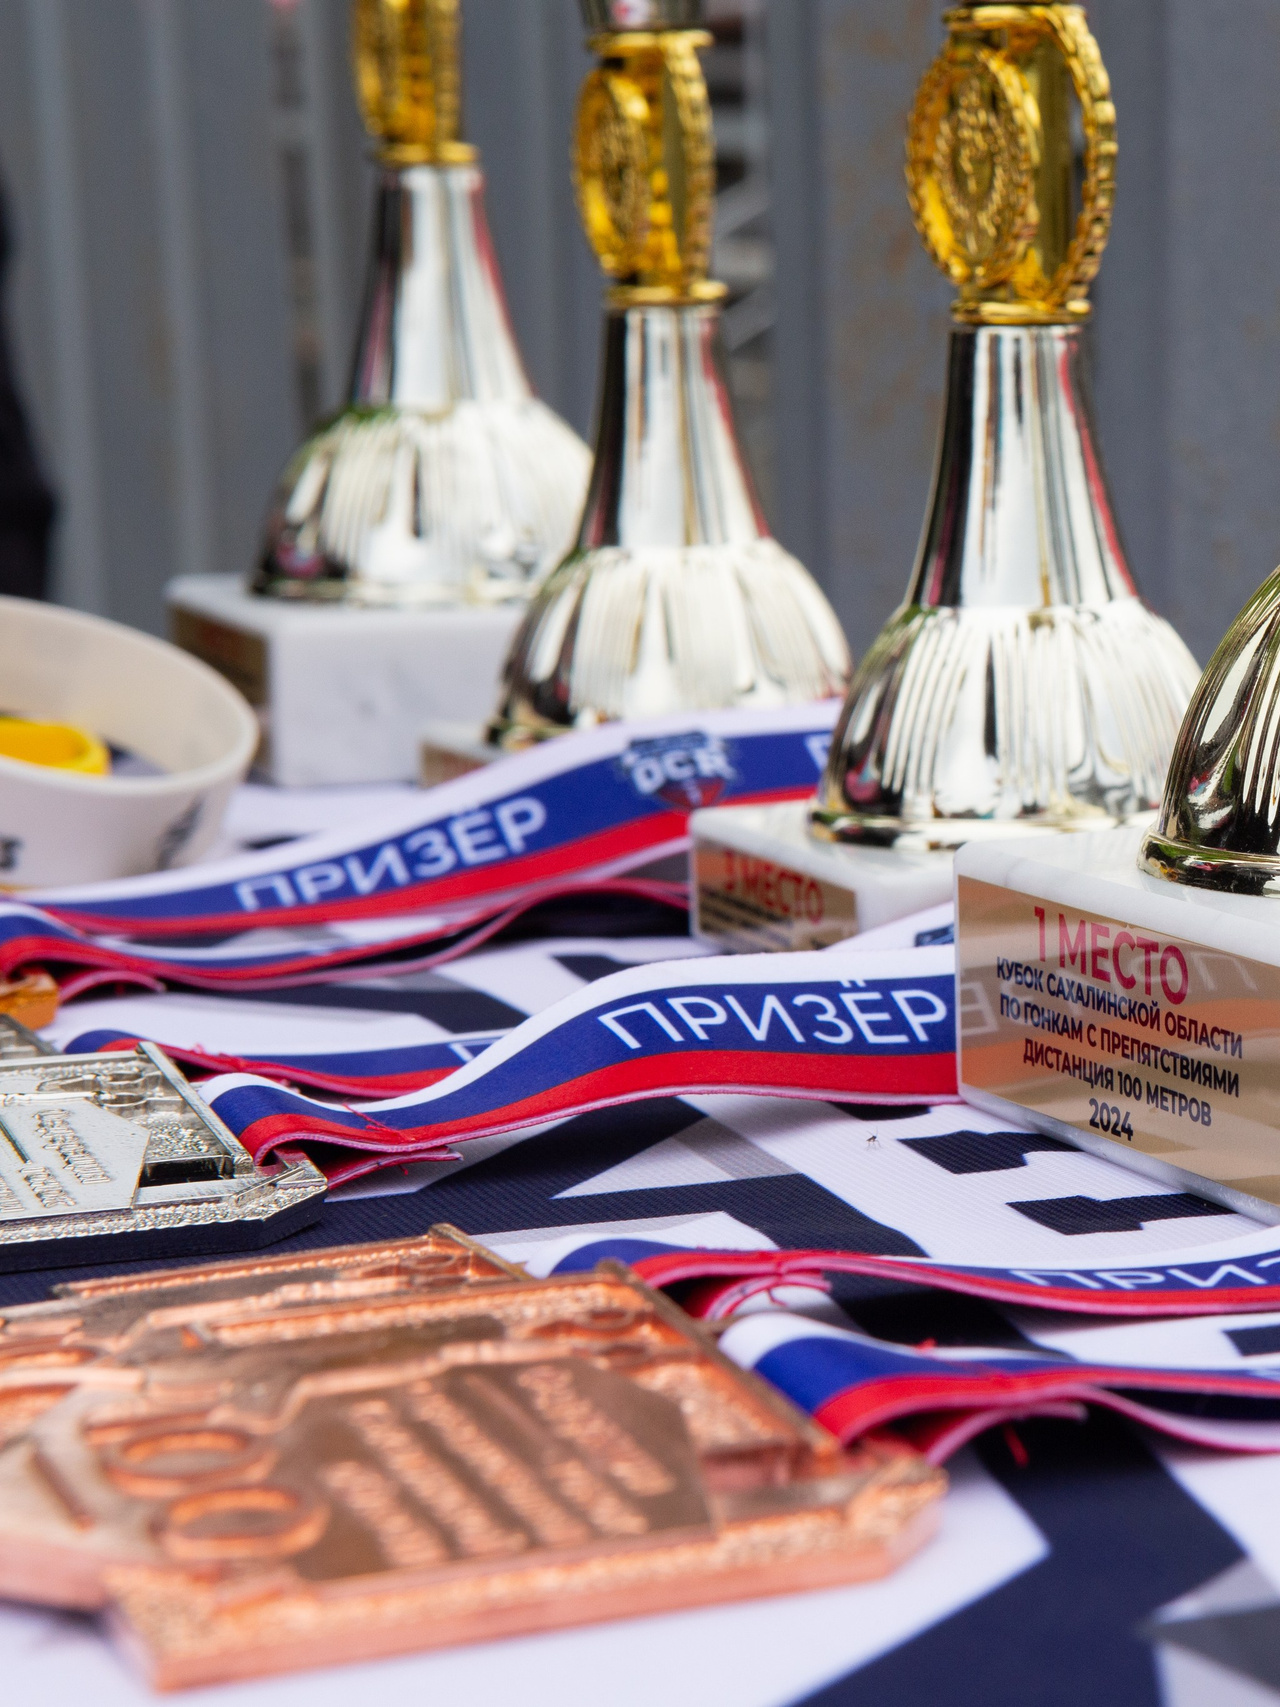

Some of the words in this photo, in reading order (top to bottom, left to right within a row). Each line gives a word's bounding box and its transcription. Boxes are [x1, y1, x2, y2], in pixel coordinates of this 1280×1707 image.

[1034, 905, 1047, 963] 1
[1058, 912, 1189, 1005] МЕСТО
[597, 979, 948, 1050] ПРИЗЁР
[996, 956, 1044, 993] КУБОК
[1046, 972, 1161, 1032] САХАЛИНСКОЙ
[1164, 1011, 1243, 1059] ОБЛАСТИ
[999, 993, 1021, 1020] ПО
[1023, 1000, 1083, 1044] ГОНКАМ
[1086, 1023, 1097, 1048] С
[1100, 1029, 1240, 1098] ПРЕПЯТСТВИЯМИ
[1023, 1037, 1114, 1093] ДИСТАНЦИЯ
[1117, 1071, 1143, 1101] 100
[1146, 1081, 1212, 1127] МЕТРОВ
[1088, 1097, 1134, 1142] 2024
